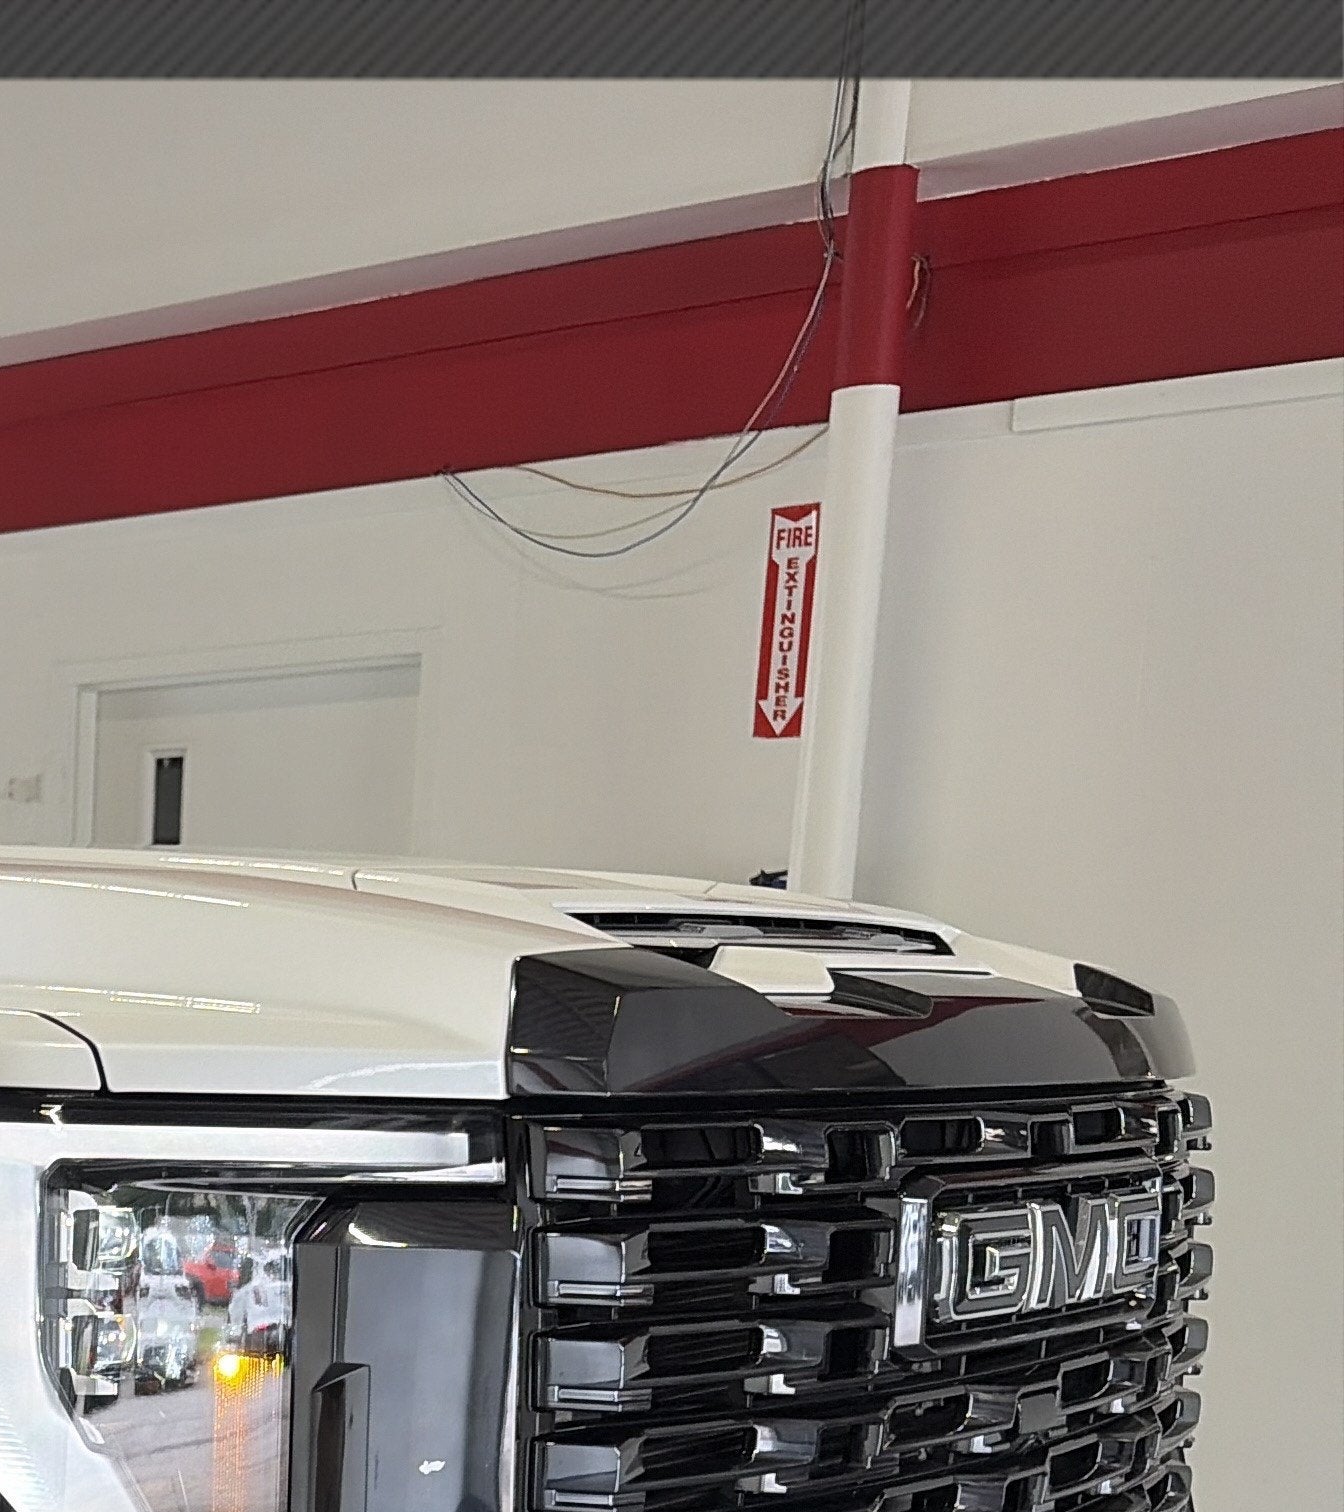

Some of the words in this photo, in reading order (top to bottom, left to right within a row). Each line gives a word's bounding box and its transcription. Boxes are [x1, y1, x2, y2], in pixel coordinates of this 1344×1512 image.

[776, 525, 813, 550] FIRE
[772, 556, 800, 722] EXTINGUISHER
[936, 1189, 1162, 1324] GMC
